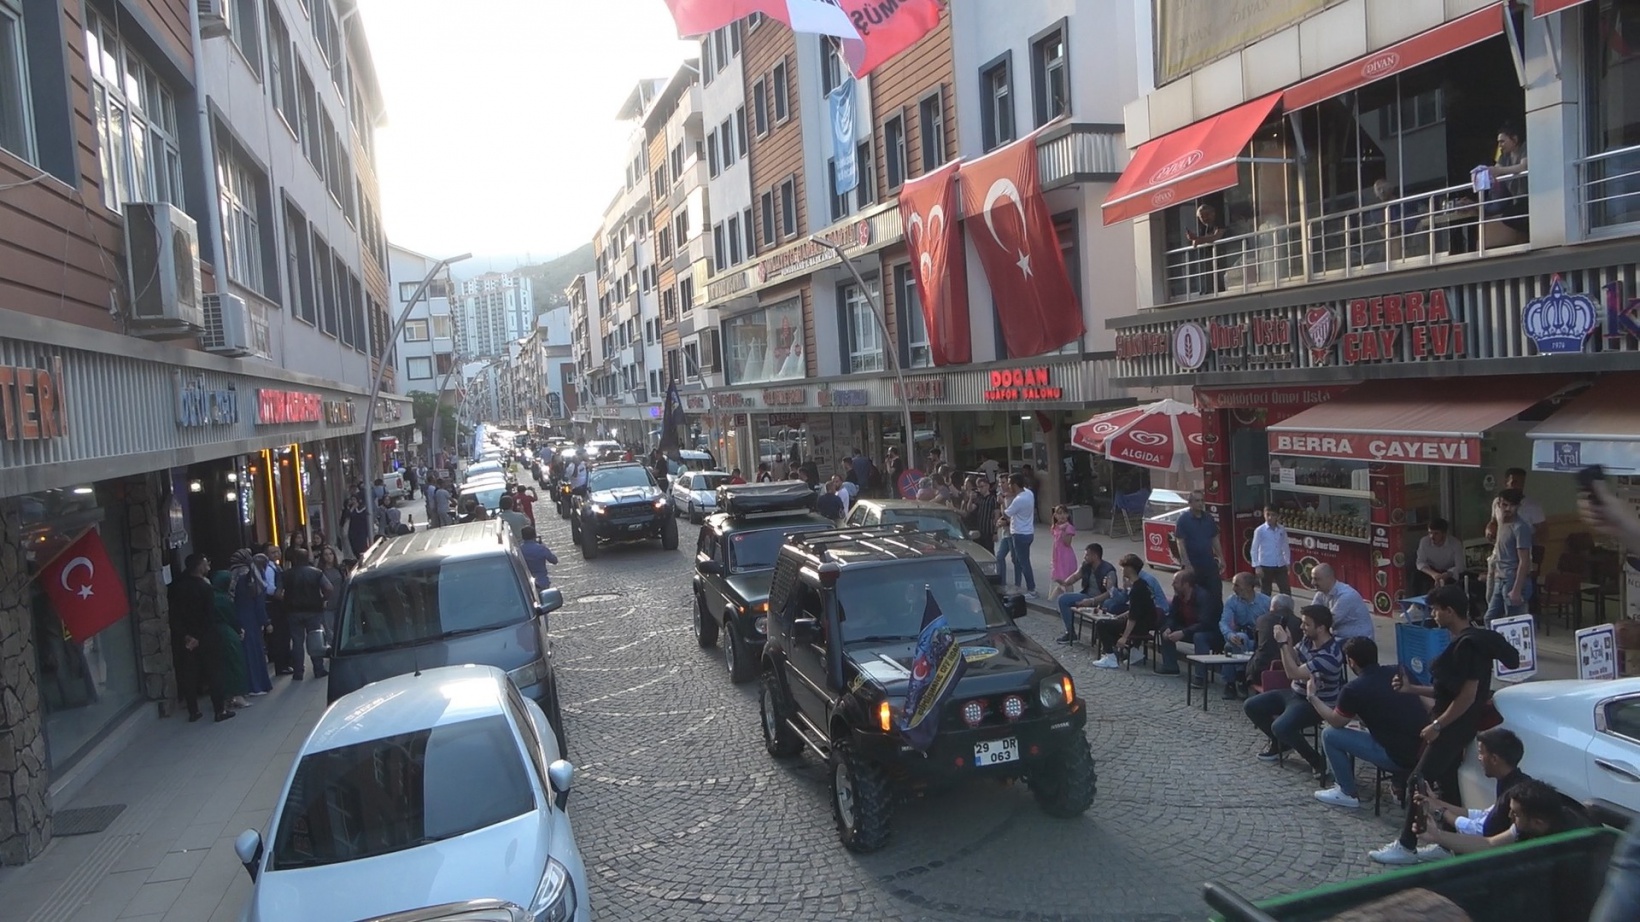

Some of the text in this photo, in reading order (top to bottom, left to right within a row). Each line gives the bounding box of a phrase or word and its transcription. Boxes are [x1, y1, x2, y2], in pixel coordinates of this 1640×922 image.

[1350, 289, 1449, 328] BERRA
[1209, 316, 1248, 351] Ömer
[1252, 316, 1291, 346] Usta
[1343, 323, 1466, 364] ÇAY EVİ
[1277, 435, 1469, 461] BERRA ÇAYEVİ
[1556, 450, 1579, 467] kral
[975, 737, 1017, 755] 29 DR
[990, 750, 1012, 763] 063
